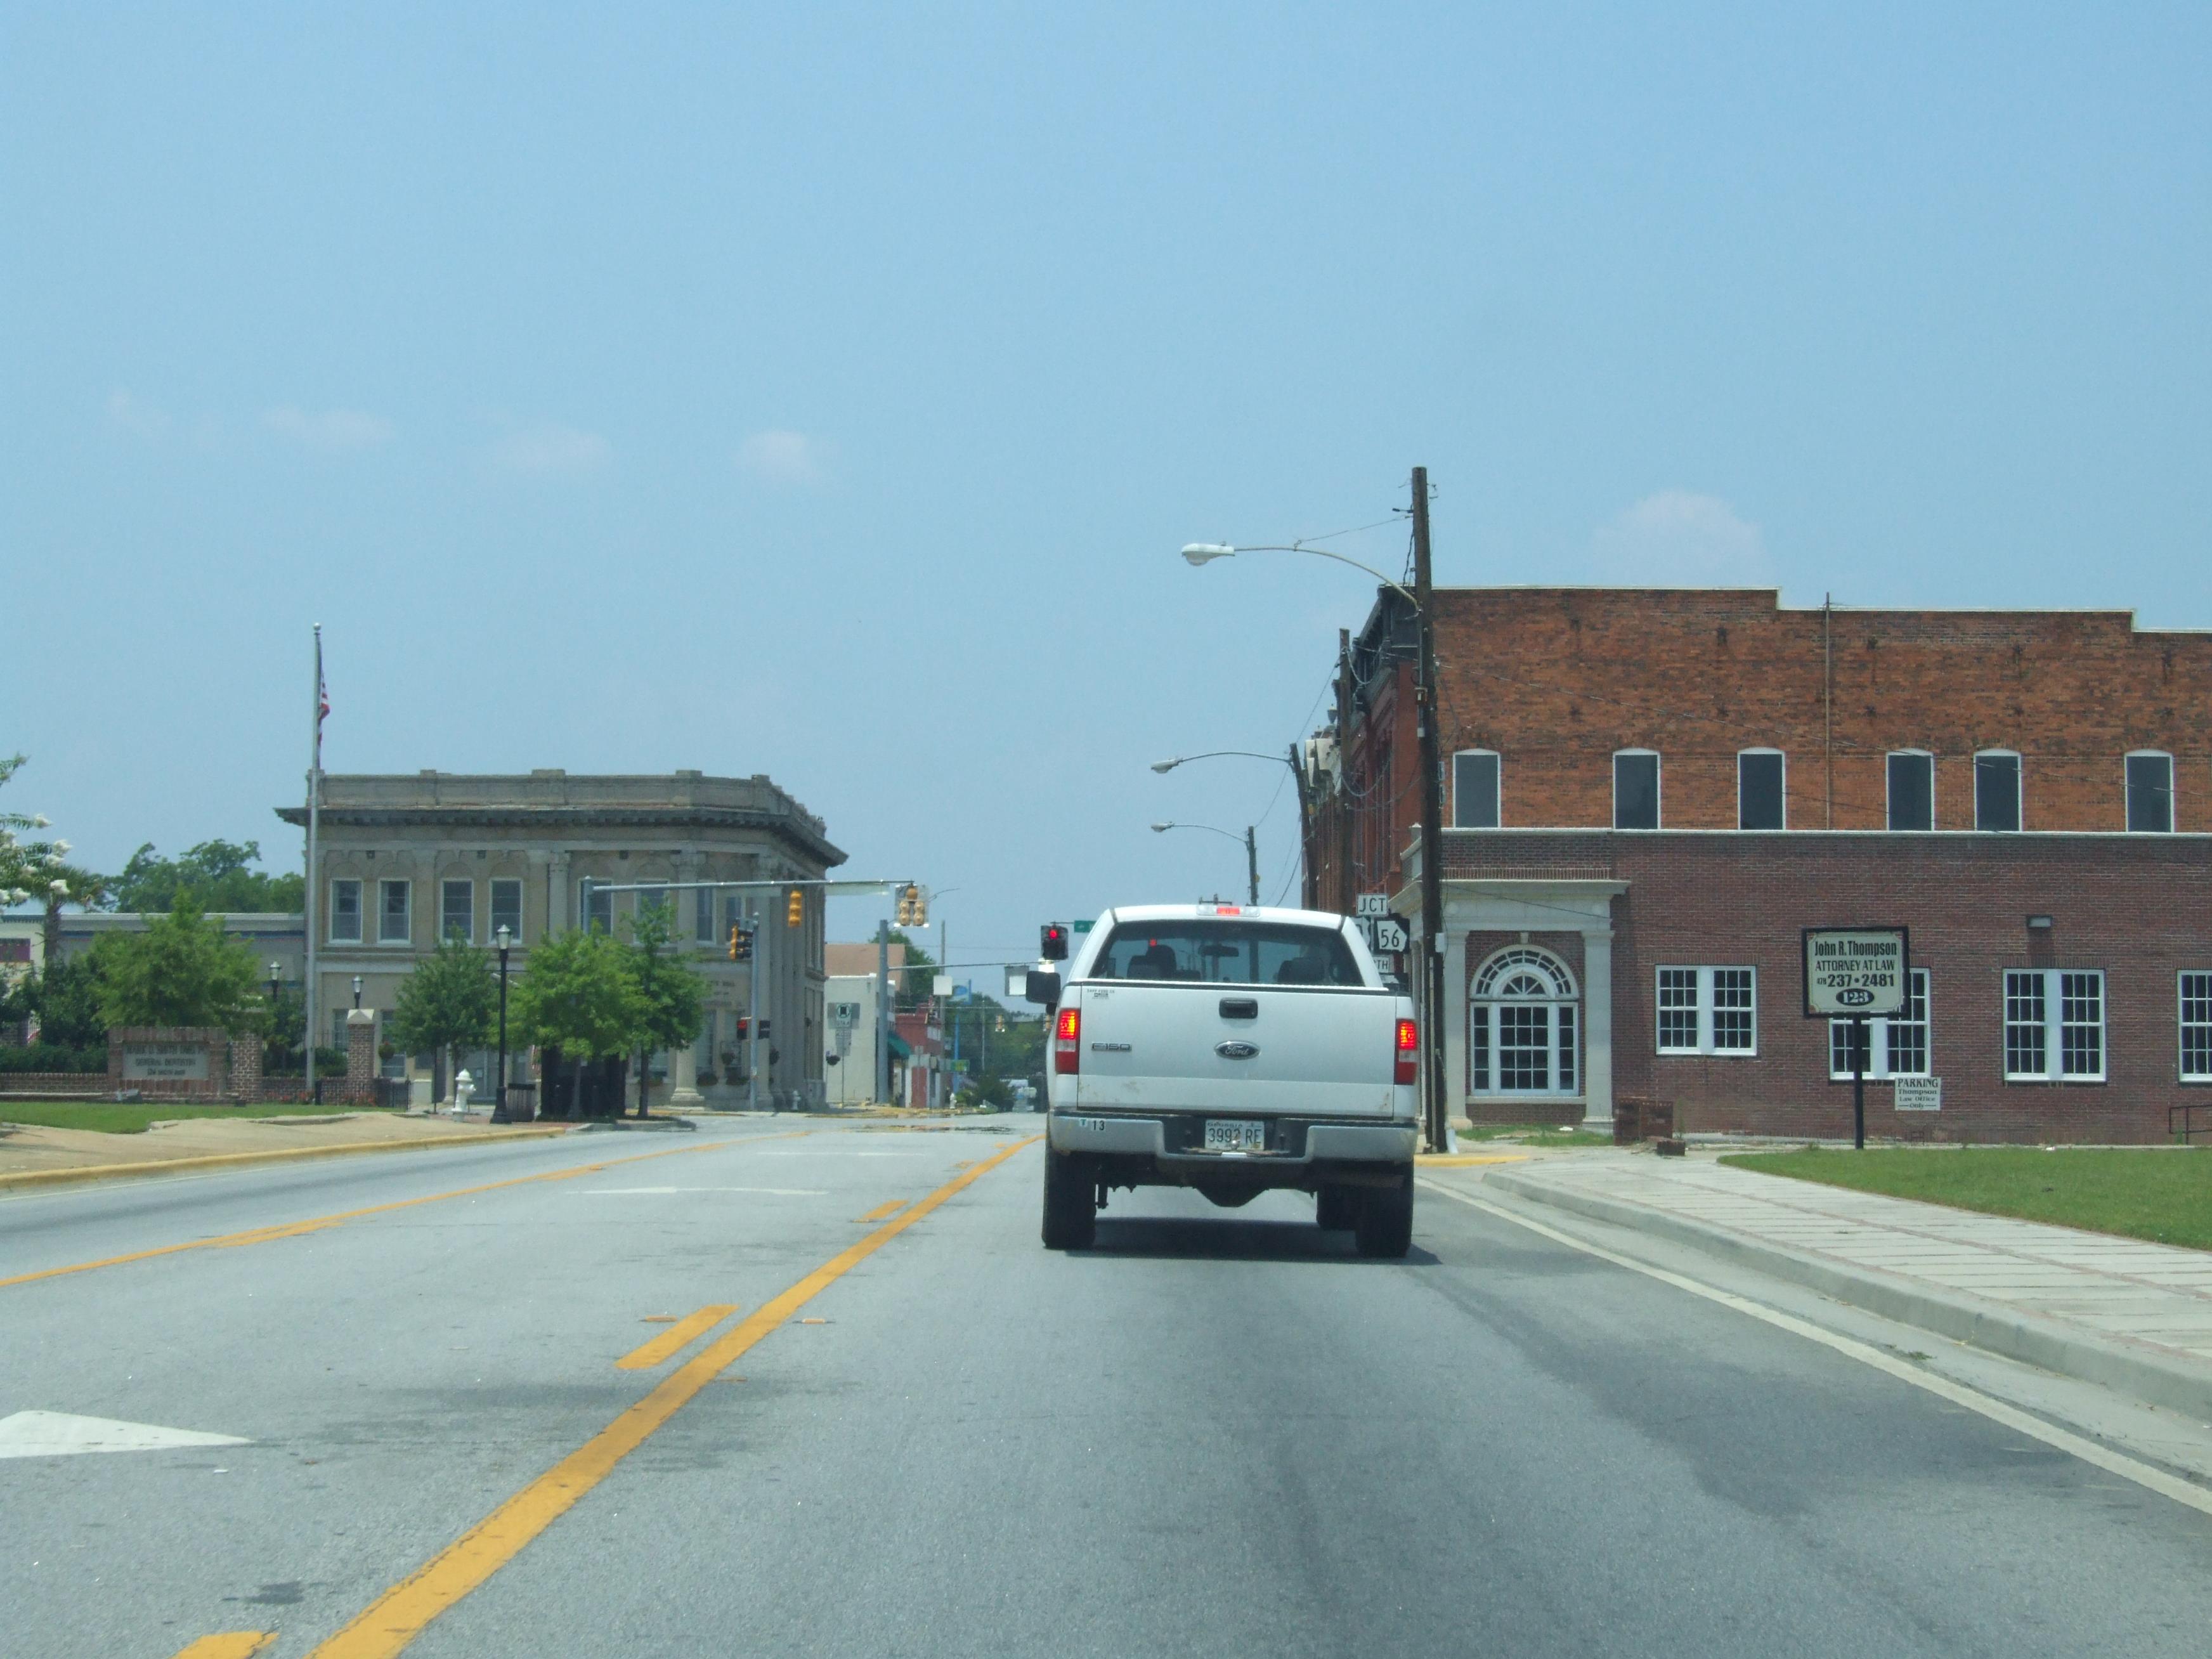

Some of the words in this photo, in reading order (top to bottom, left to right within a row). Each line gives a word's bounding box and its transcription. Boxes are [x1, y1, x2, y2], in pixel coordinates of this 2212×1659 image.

[1359, 898, 1386, 912] JCT
[1381, 929, 1400, 947] 56
[1815, 940, 1836, 956] John
[1838, 940, 1847, 956] R.
[1847, 940, 1897, 957] Thompson
[1815, 960, 1861, 971] ATTORNEY
[1862, 960, 1873, 970] AT
[1875, 960, 1895, 970] LAW
[1843, 991, 1870, 1003] 123
[1225, 1044, 1249, 1056] Ford
[1897, 1078, 1939, 1088] PARKING
[1093, 1120, 1105, 1131] 13
